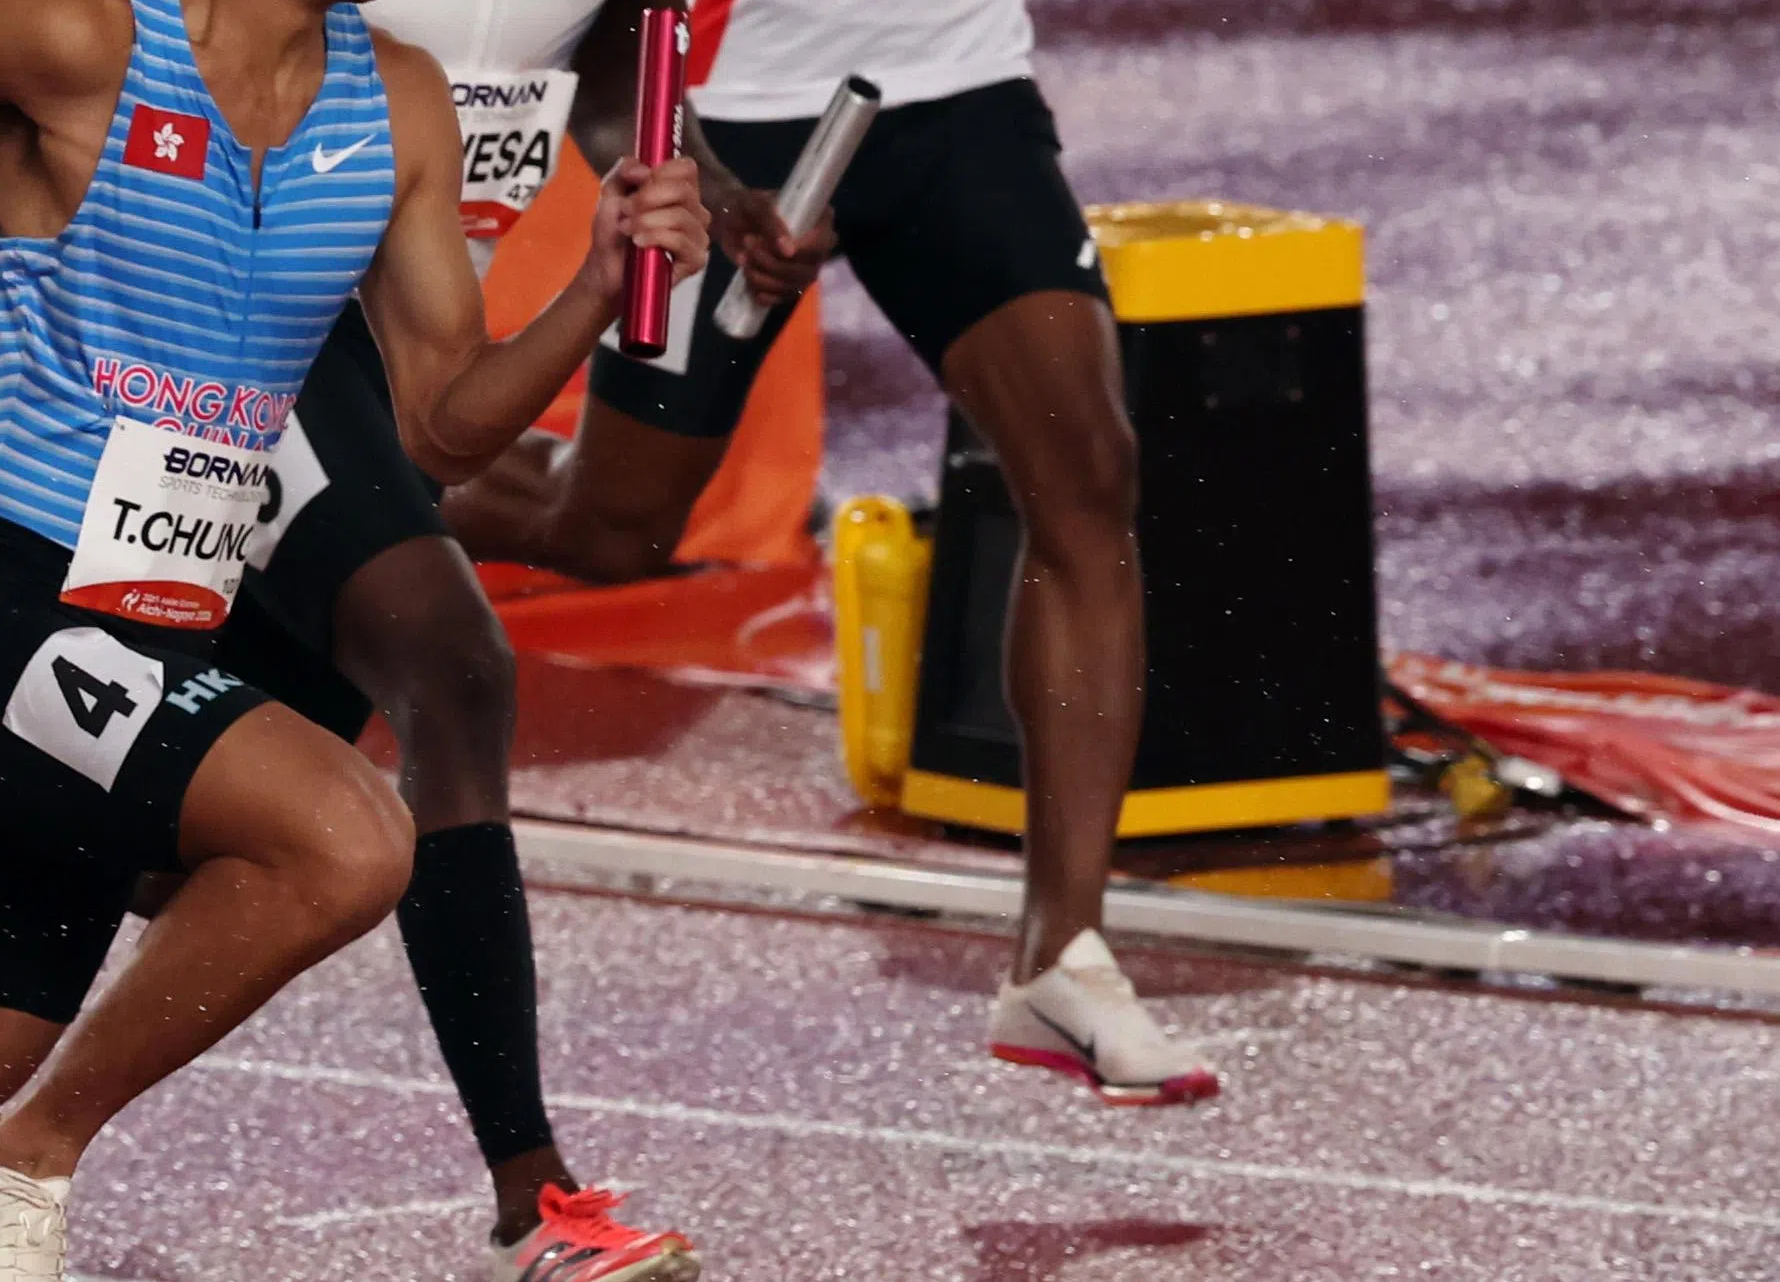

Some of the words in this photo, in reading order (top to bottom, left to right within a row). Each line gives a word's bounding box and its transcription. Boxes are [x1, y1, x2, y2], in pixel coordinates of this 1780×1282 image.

[451, 80, 548, 108] ORNAN
[93, 356, 227, 423] HONG
[51, 655, 138, 739] 4
[165, 668, 244, 715] HK
